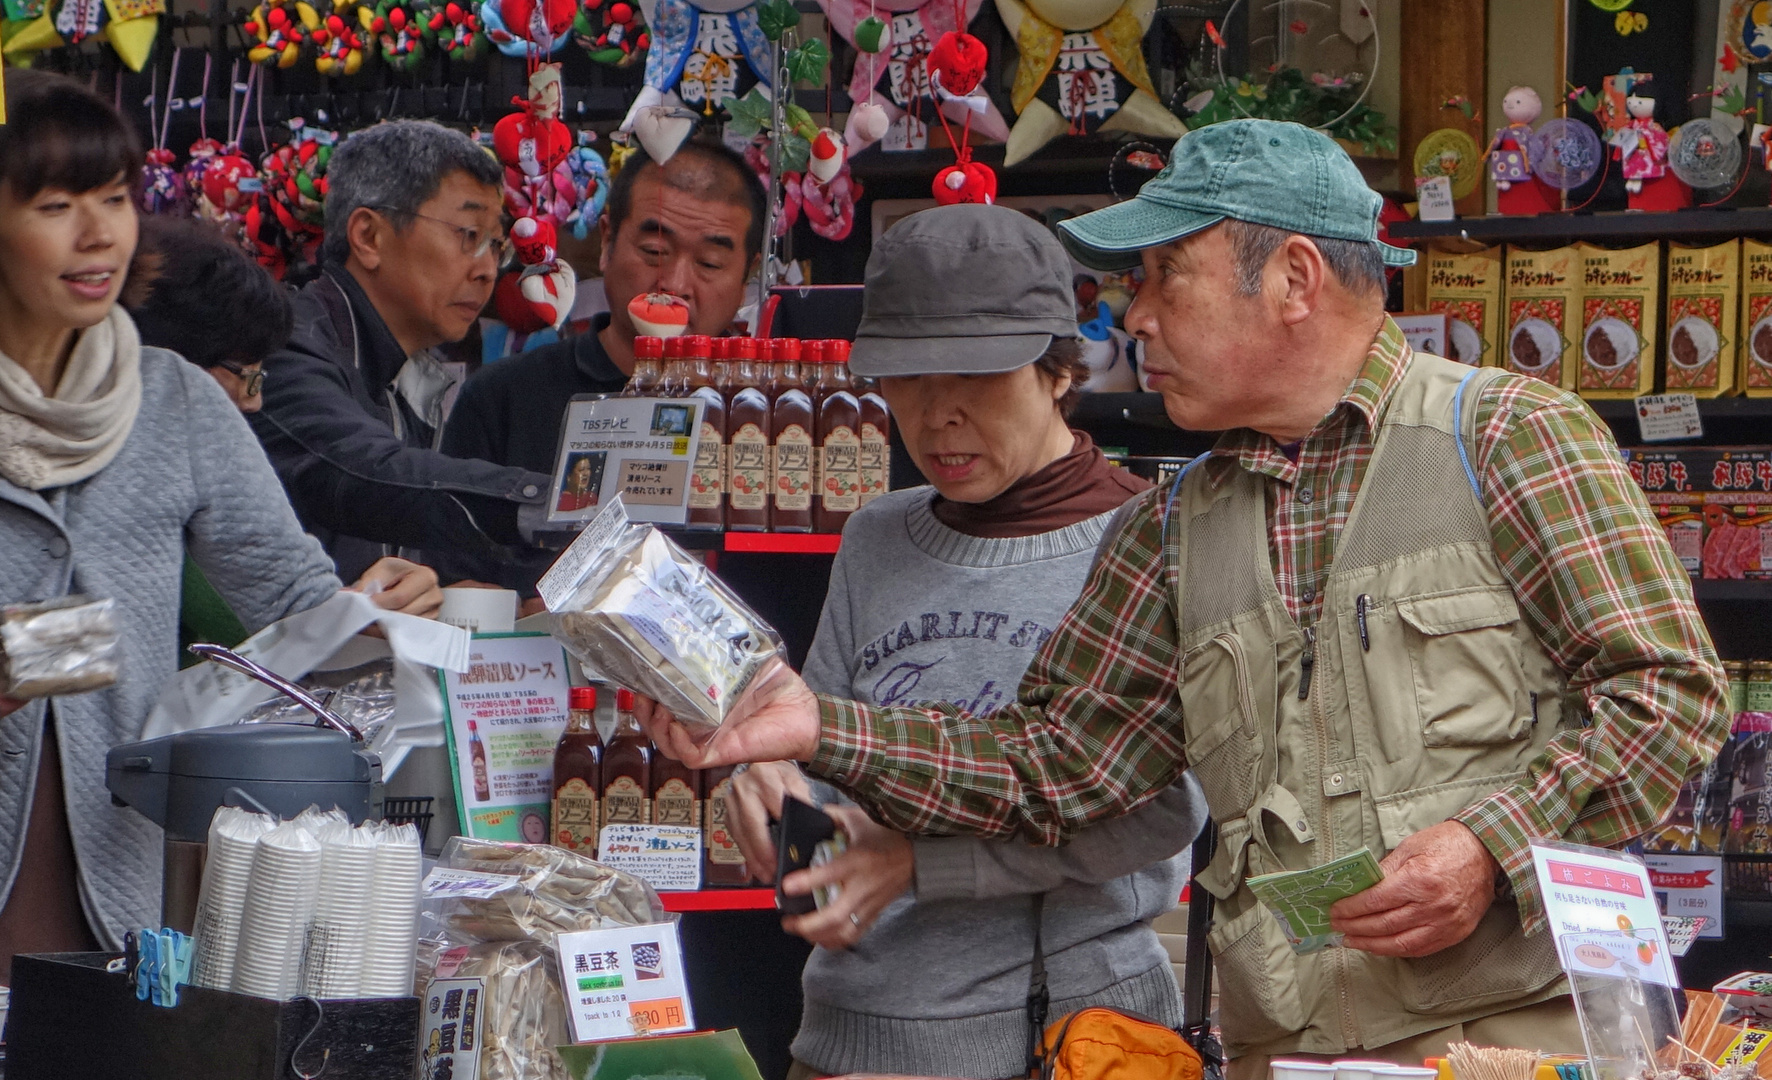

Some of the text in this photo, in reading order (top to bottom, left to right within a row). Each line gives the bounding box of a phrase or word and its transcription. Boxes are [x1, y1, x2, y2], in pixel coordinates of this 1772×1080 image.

[734, 453, 764, 466] ソース
[779, 454, 809, 467] ソース
[826, 455, 858, 468] ソース
[863, 611, 1009, 671] STARLIT
[559, 808, 591, 820] ソース
[608, 807, 639, 819] ソース
[659, 808, 691, 822] ソース
[574, 950, 620, 973] 黒豆茶
